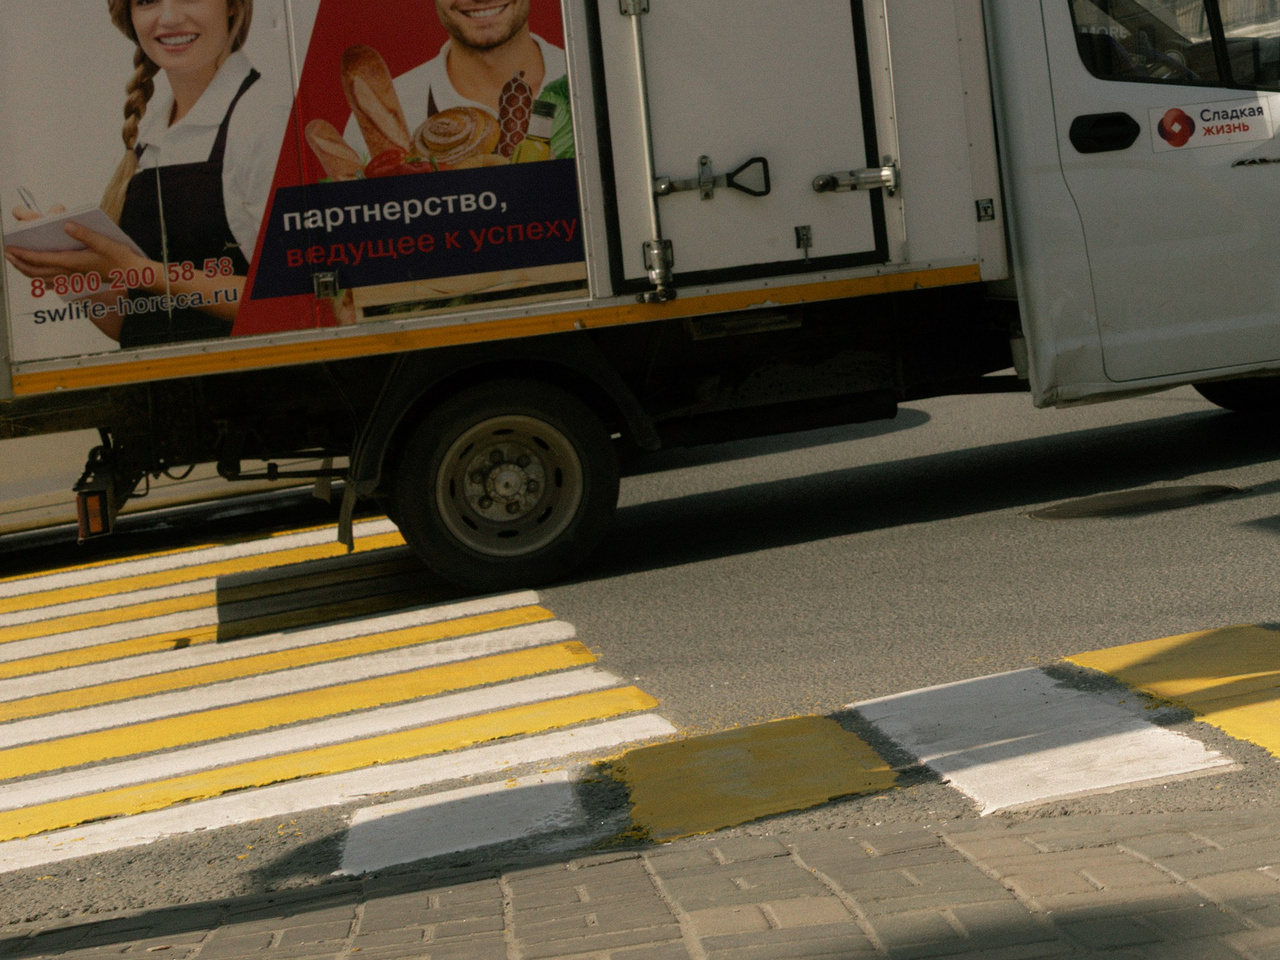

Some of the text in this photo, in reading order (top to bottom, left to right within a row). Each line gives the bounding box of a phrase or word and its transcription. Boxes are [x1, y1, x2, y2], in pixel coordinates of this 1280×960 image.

[1200, 106, 1264, 123] Сладкая
[1203, 122, 1250, 137] жизнь
[282, 190, 508, 233] партнерство,
[286, 217, 578, 268] ведущее к успеху
[30, 257, 234, 298] 8 800 200 58 58
[33, 287, 238, 324] swlife-horeca.ru
